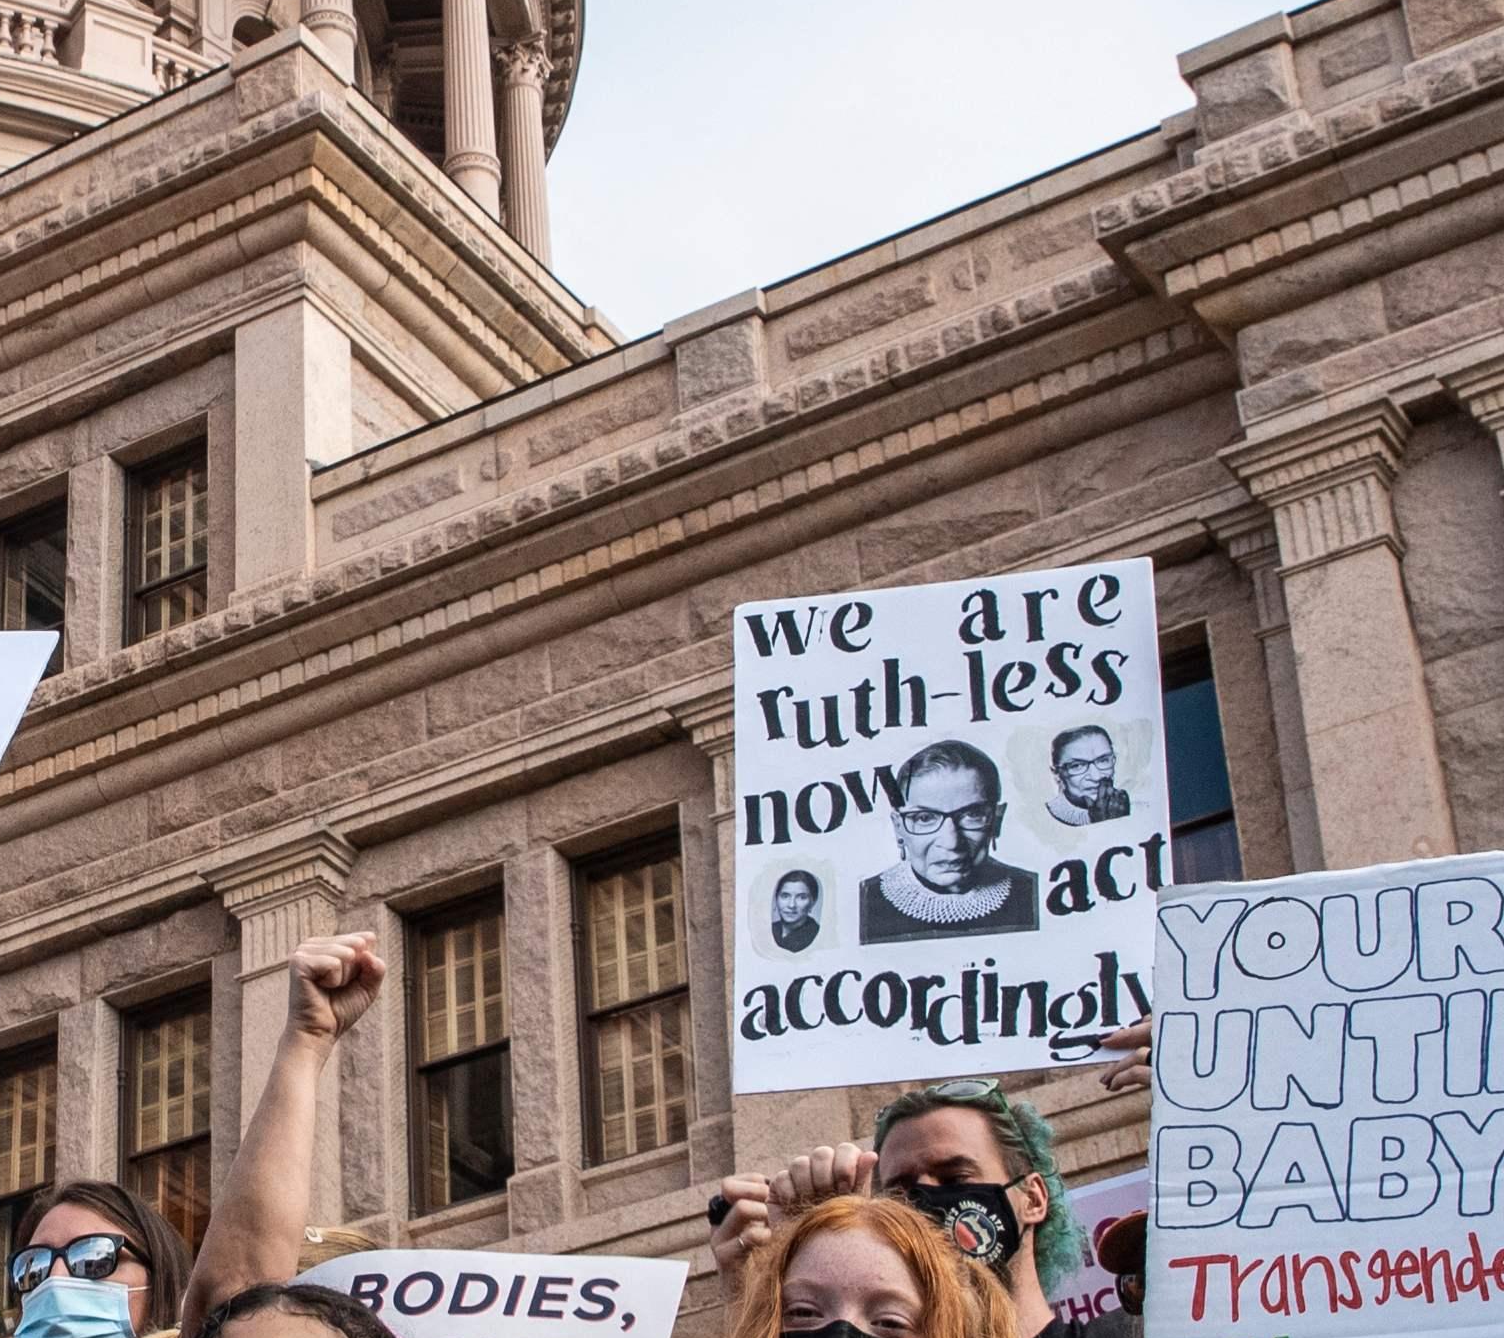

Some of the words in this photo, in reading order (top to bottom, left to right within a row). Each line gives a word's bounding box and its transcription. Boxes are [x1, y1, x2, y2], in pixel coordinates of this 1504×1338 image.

[744, 601, 873, 658] we
[958, 573, 1122, 644] are
[743, 763, 914, 845] now
[1045, 832, 1167, 916] act
